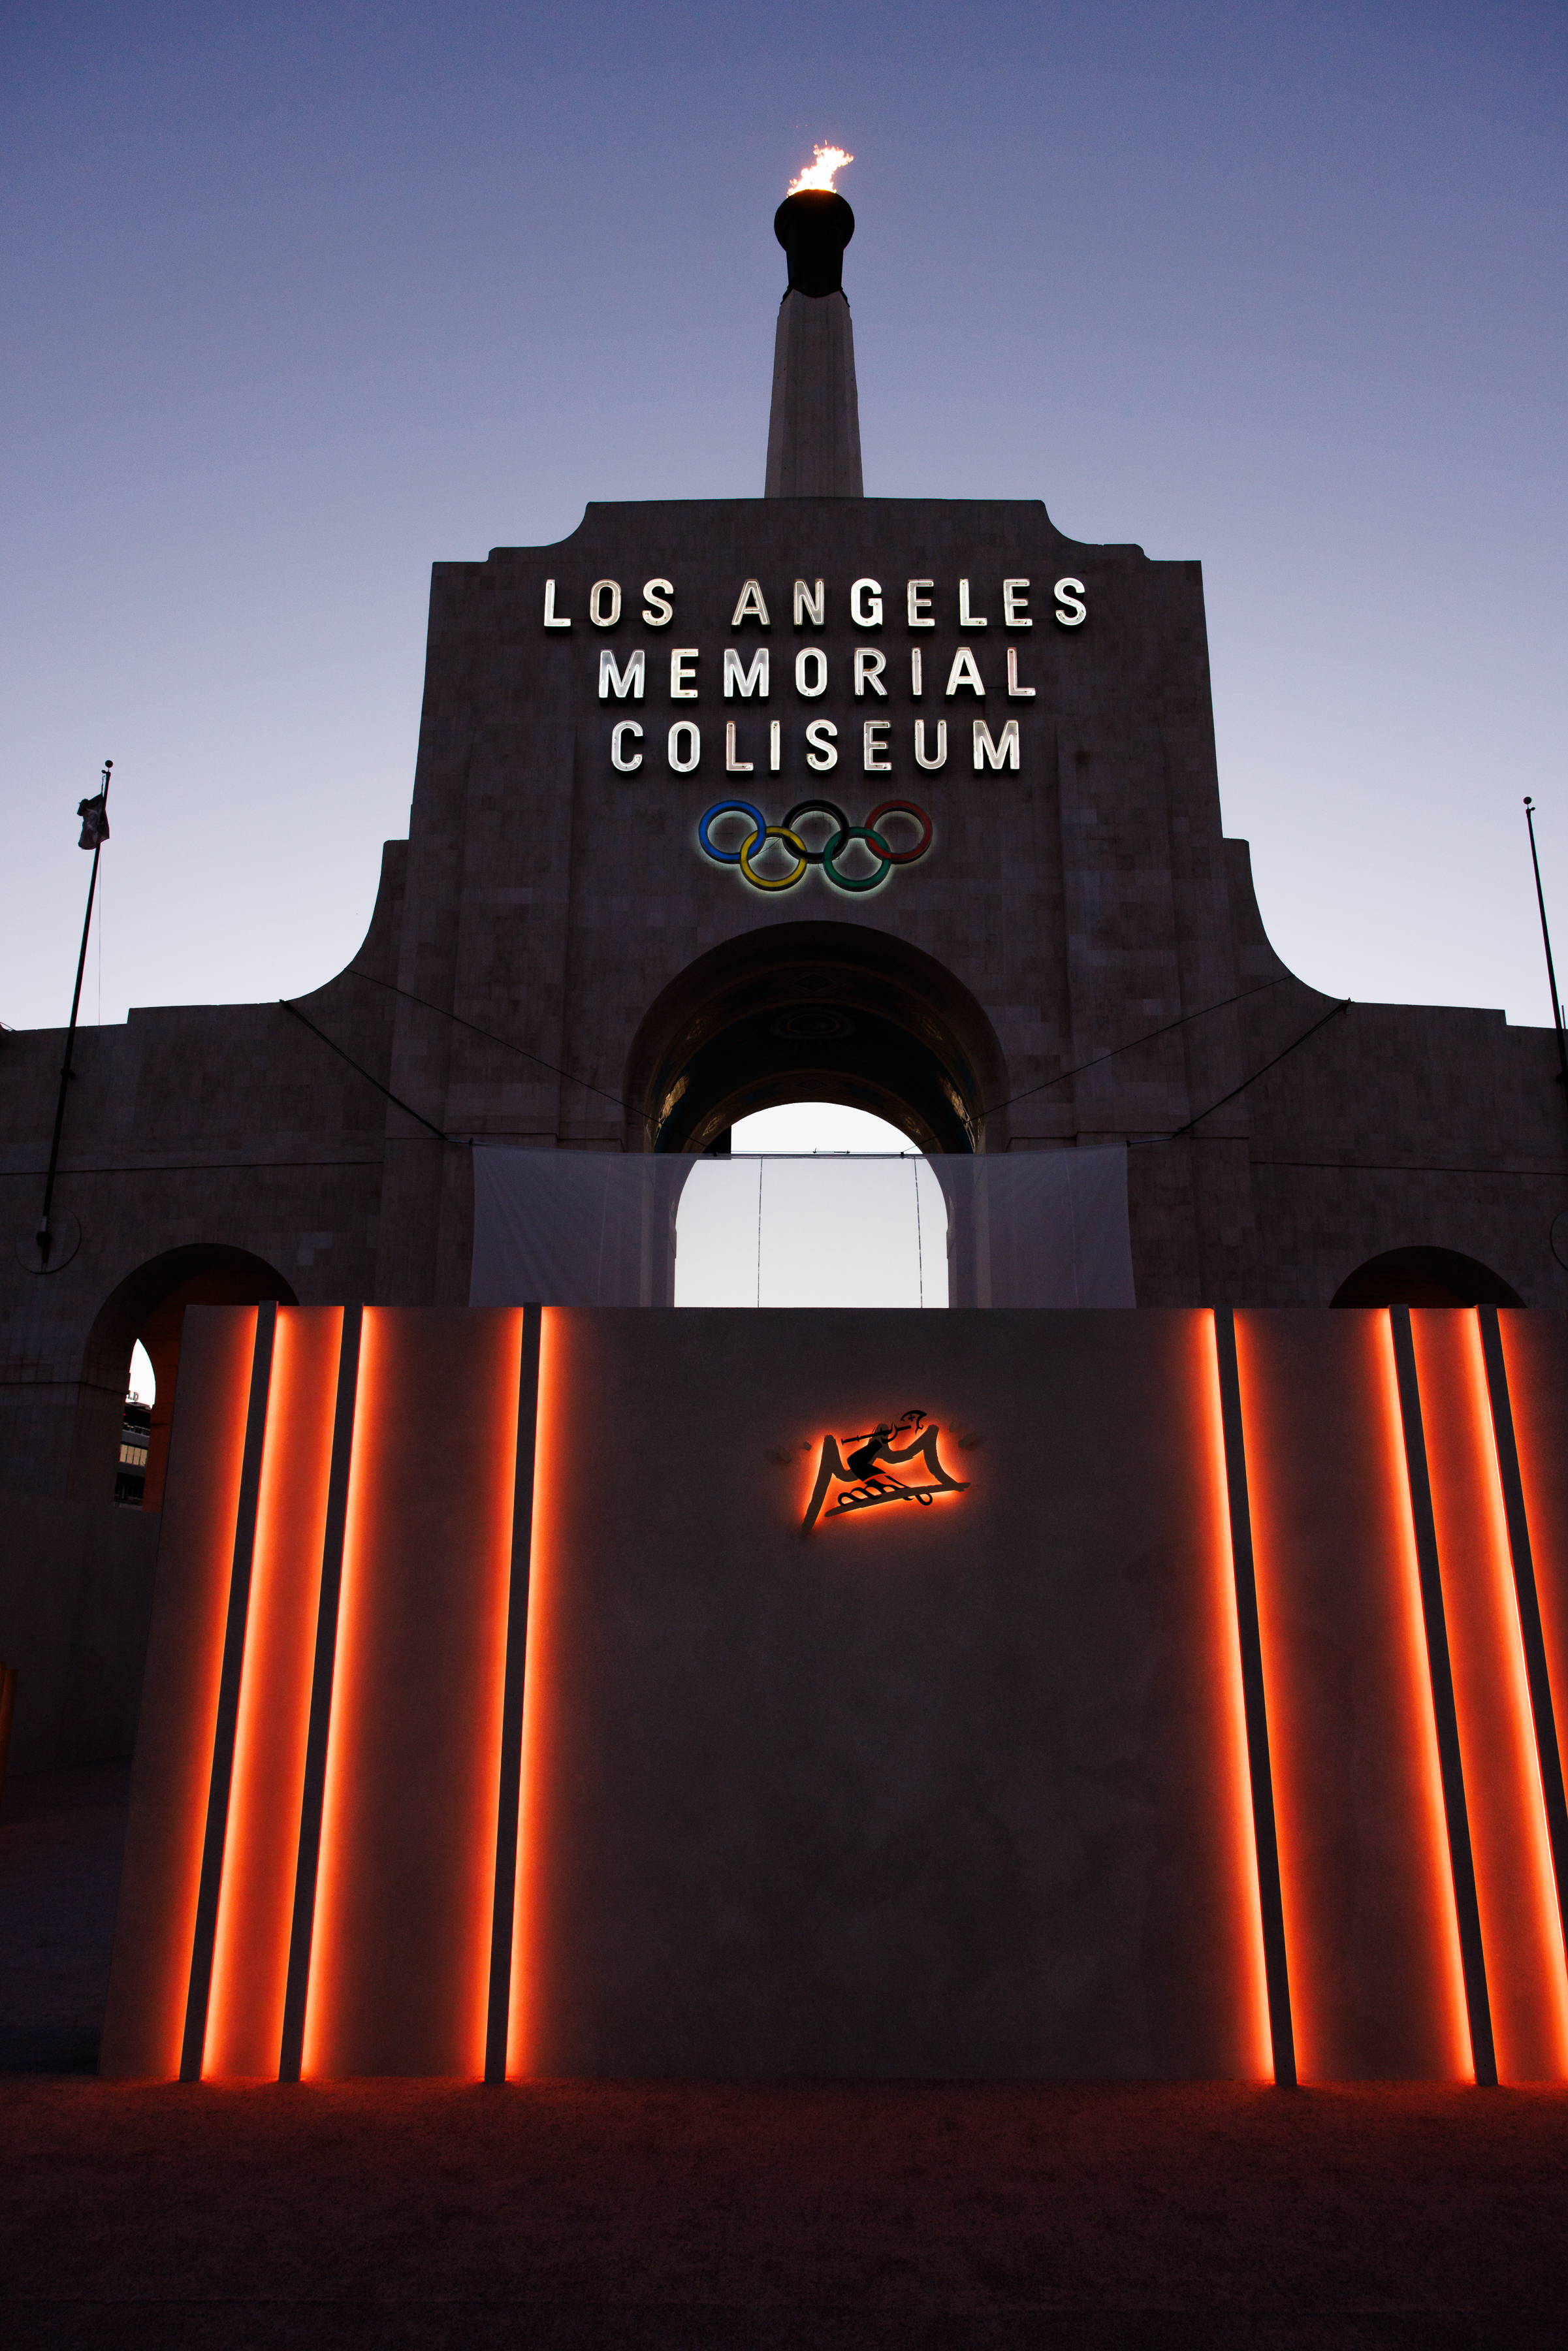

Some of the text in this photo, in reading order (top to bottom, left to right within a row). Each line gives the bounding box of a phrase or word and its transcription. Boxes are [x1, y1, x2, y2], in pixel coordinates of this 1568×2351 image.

[544, 577, 1087, 627] LOS ANGELES
[598, 647, 1036, 698] MEMORIAL
[611, 719, 1020, 773] COLISEUM
